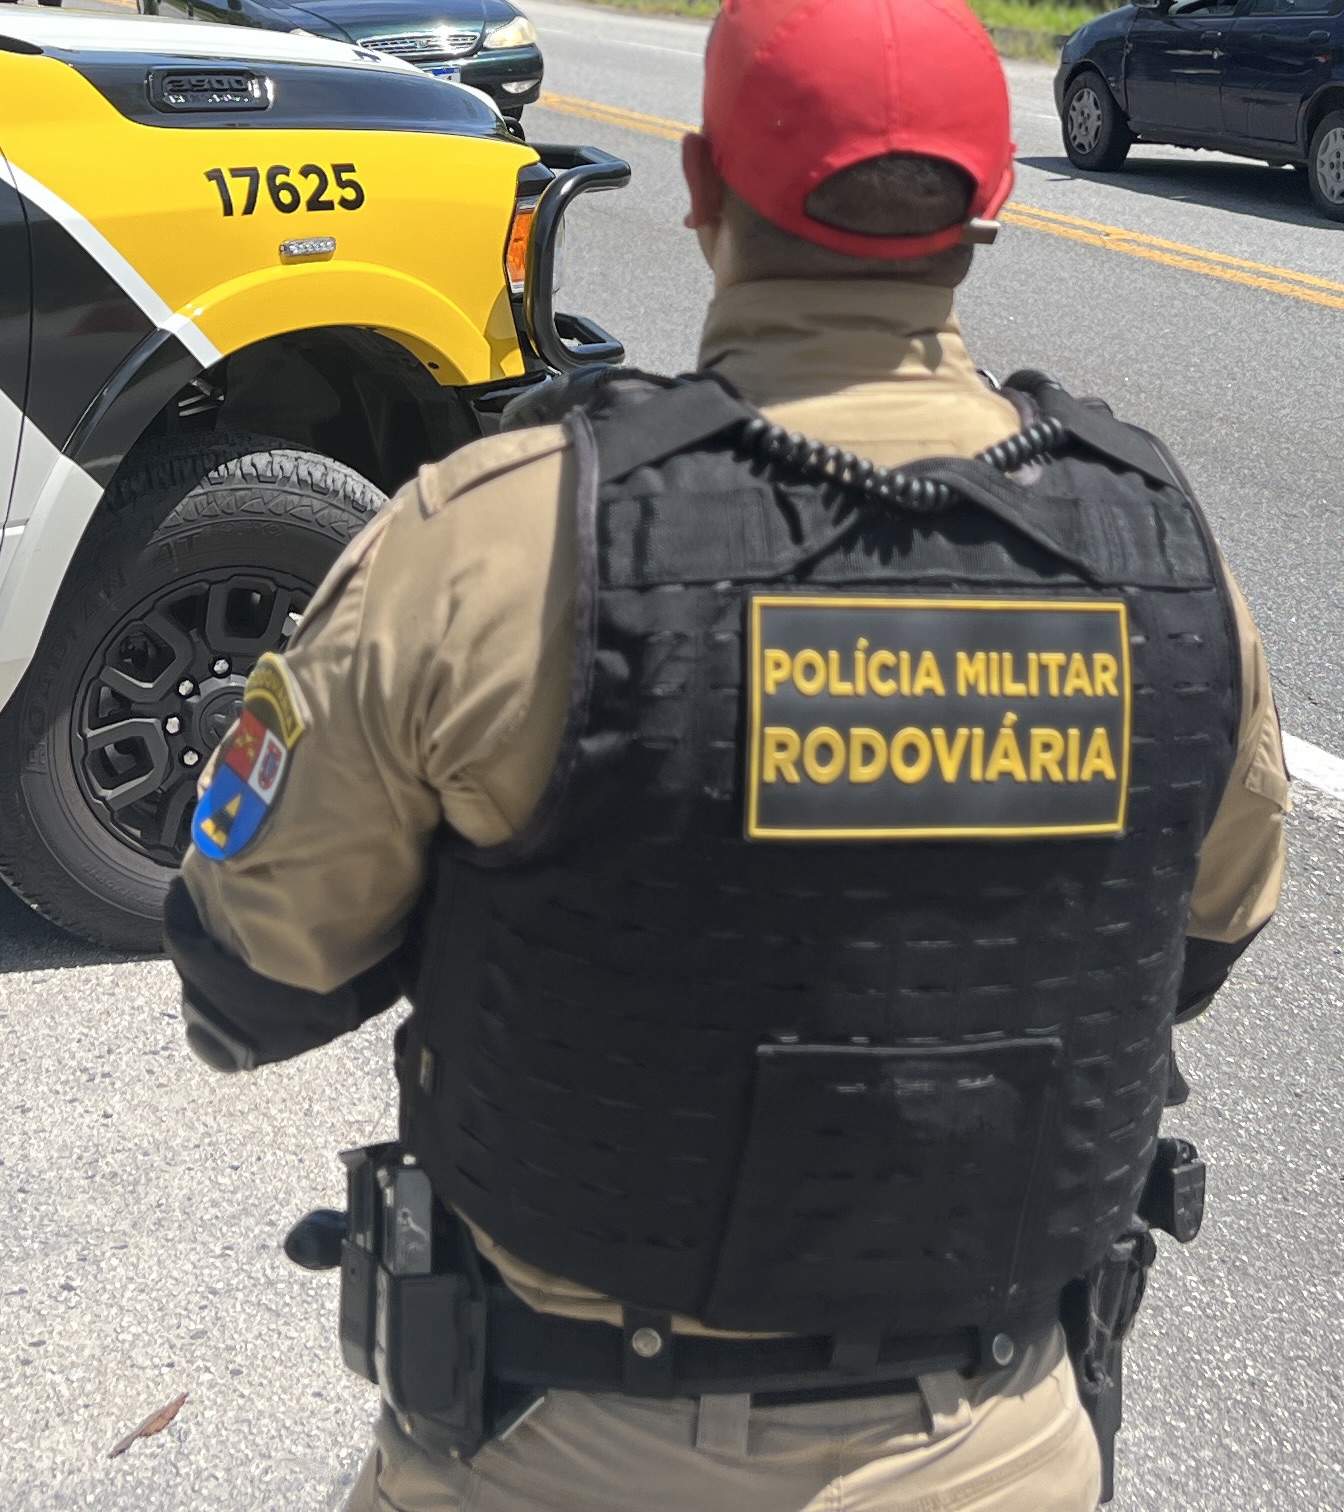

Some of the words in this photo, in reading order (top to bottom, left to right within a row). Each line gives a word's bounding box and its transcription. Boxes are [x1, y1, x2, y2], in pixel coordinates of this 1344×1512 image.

[204, 163, 366, 217] 17625
[763, 636, 946, 697] POLÍCIA
[956, 650, 1119, 697] MILITAR
[762, 710, 1117, 785] RODOVIÁRIA
